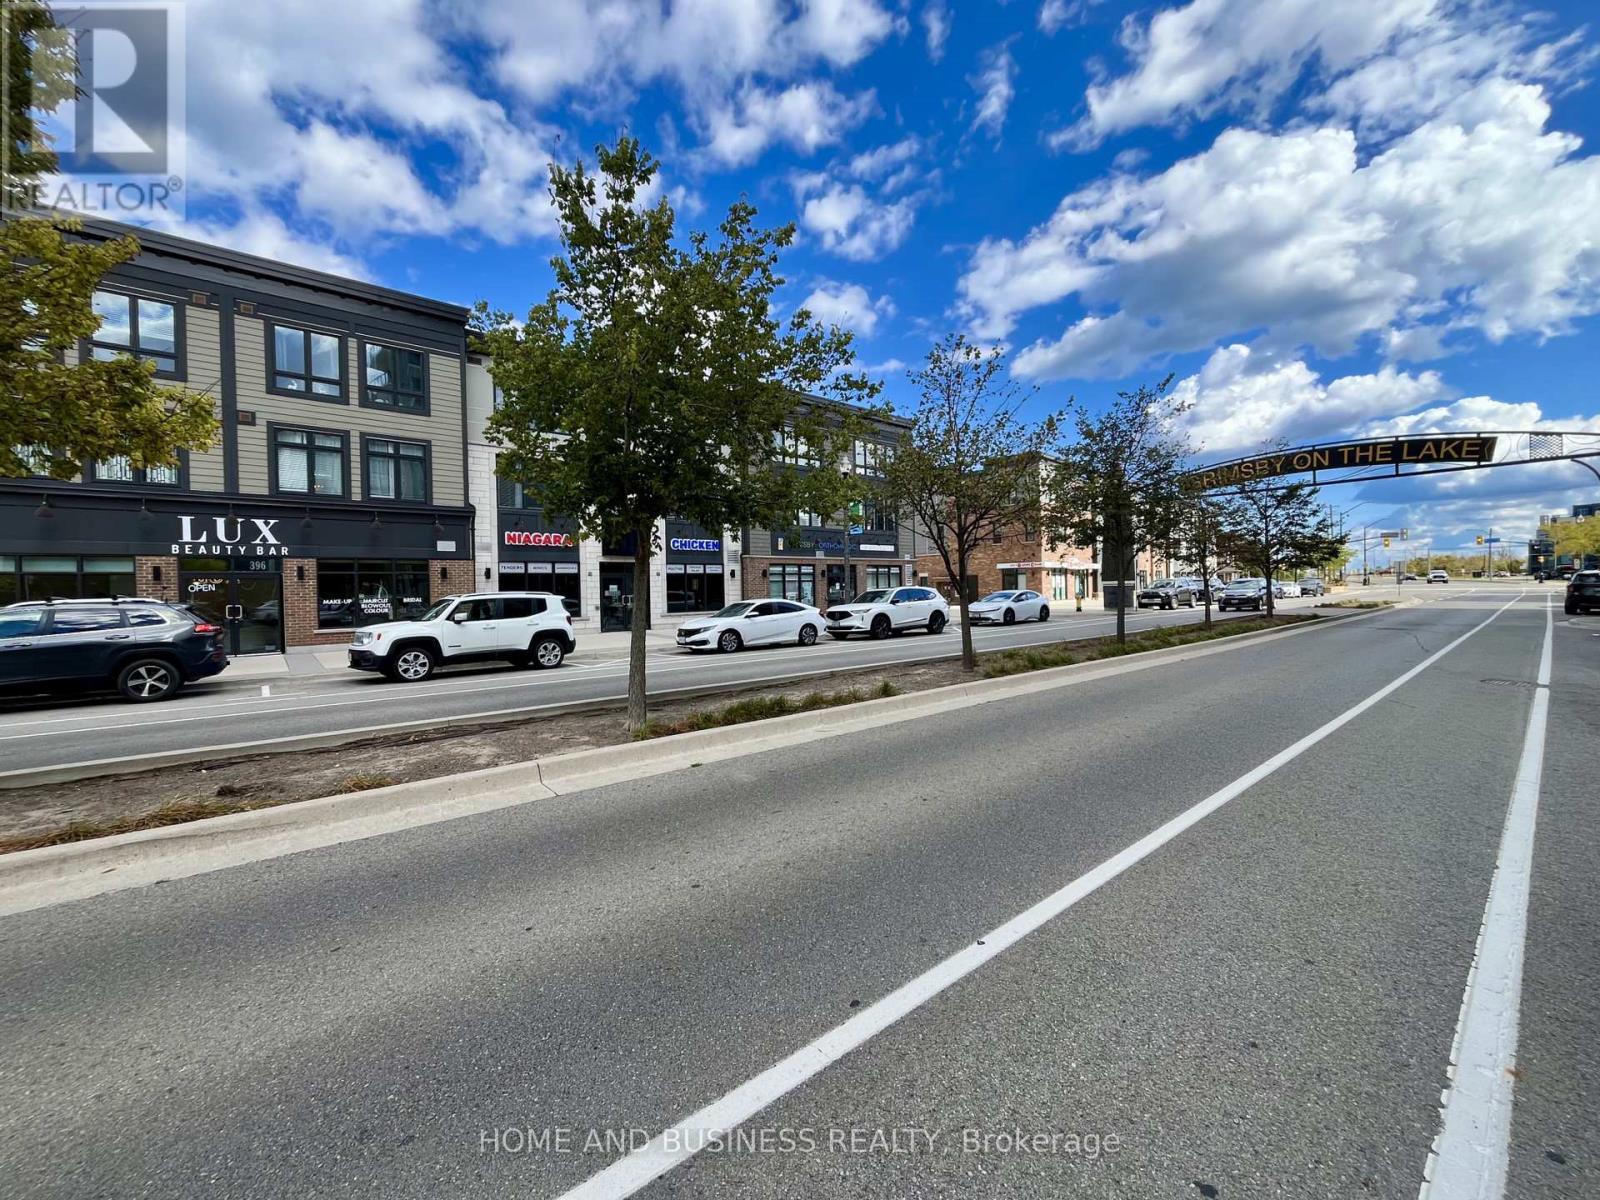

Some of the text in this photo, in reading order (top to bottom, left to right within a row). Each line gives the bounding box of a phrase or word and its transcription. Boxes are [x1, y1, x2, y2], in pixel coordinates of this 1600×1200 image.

[1293, 450, 1329, 470] ON
[1338, 443, 1393, 464] THE
[1402, 439, 1482, 460] LAKE
[177, 515, 281, 544] LUX
[505, 531, 574, 547] NIAGARA
[670, 538, 721, 551] CHICKEN
[171, 544, 289, 556] BEAUTY BAR
[249, 560, 266, 570] 396
[188, 583, 216, 593] OPEN
